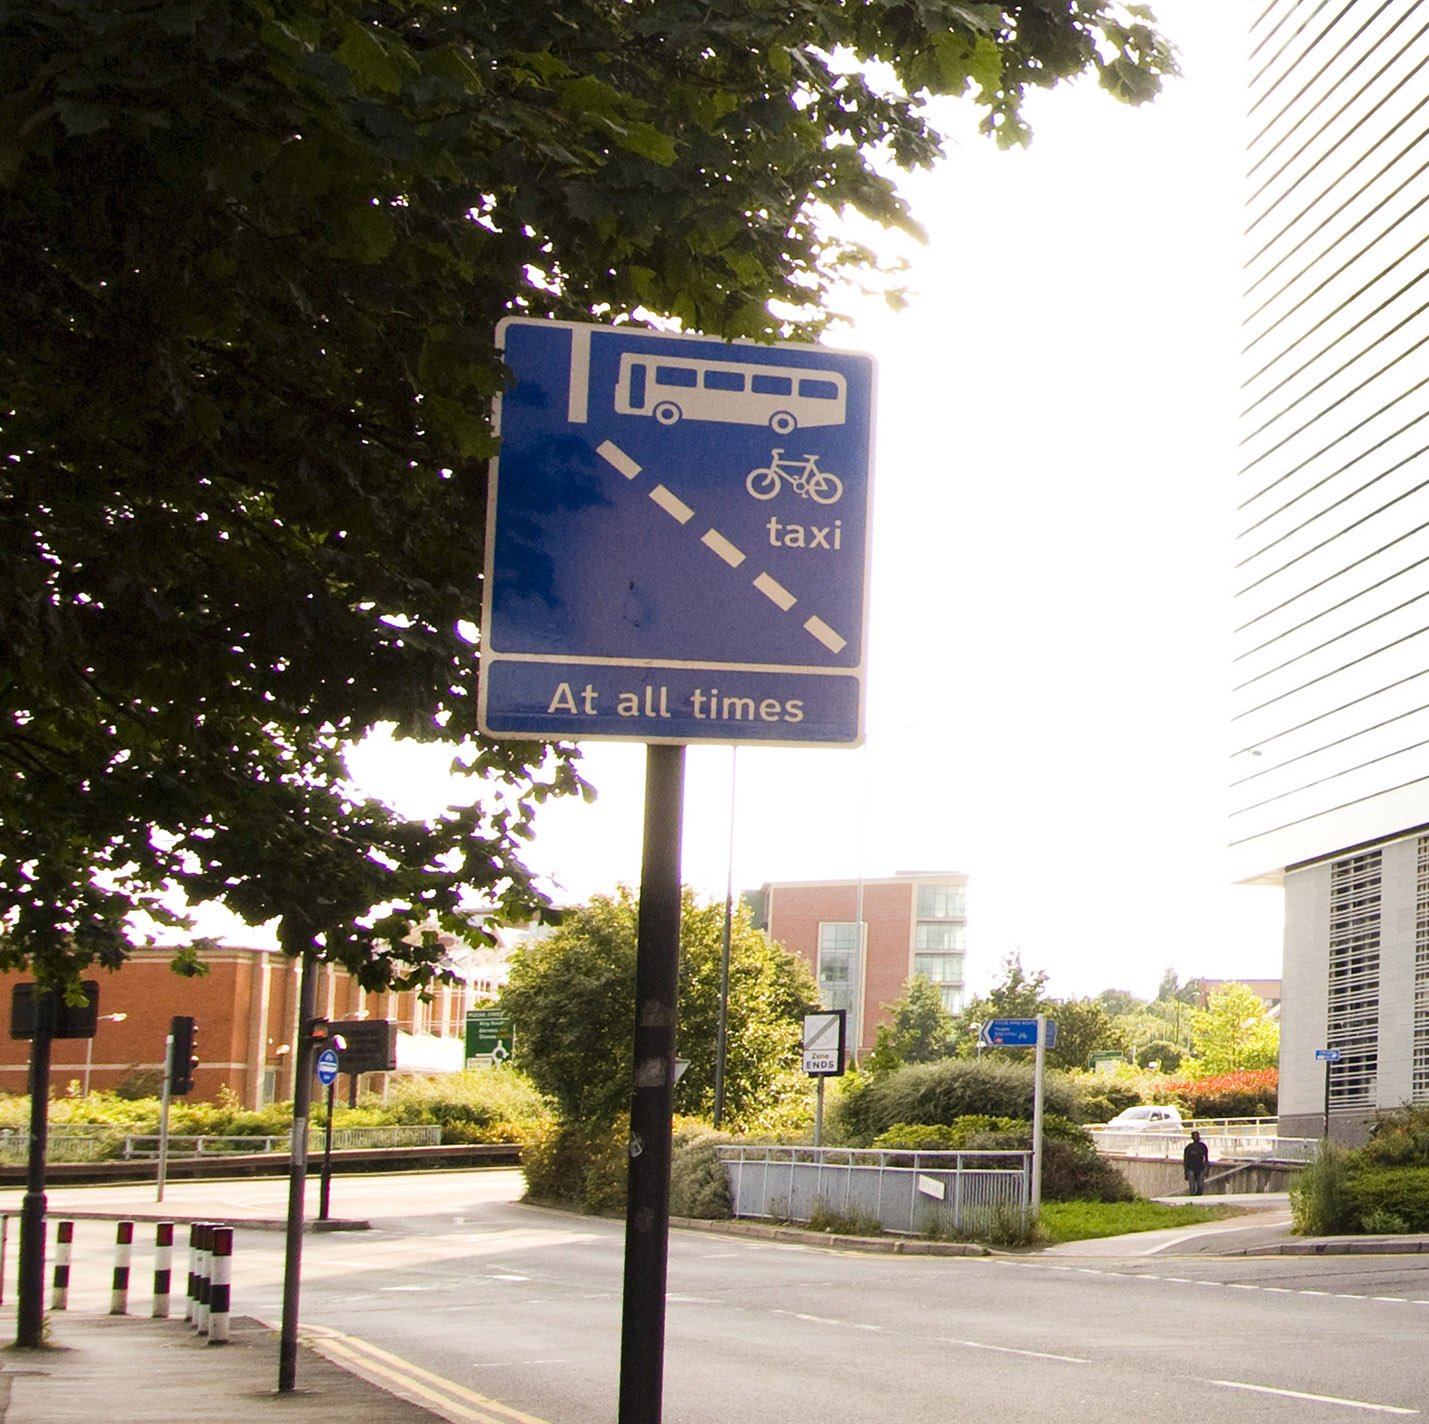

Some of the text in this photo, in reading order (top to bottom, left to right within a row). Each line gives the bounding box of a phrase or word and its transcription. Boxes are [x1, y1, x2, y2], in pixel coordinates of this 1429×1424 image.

[766, 516, 842, 550] taxi
[547, 682, 804, 722] At all times
[806, 1061, 834, 1069] ENDS
